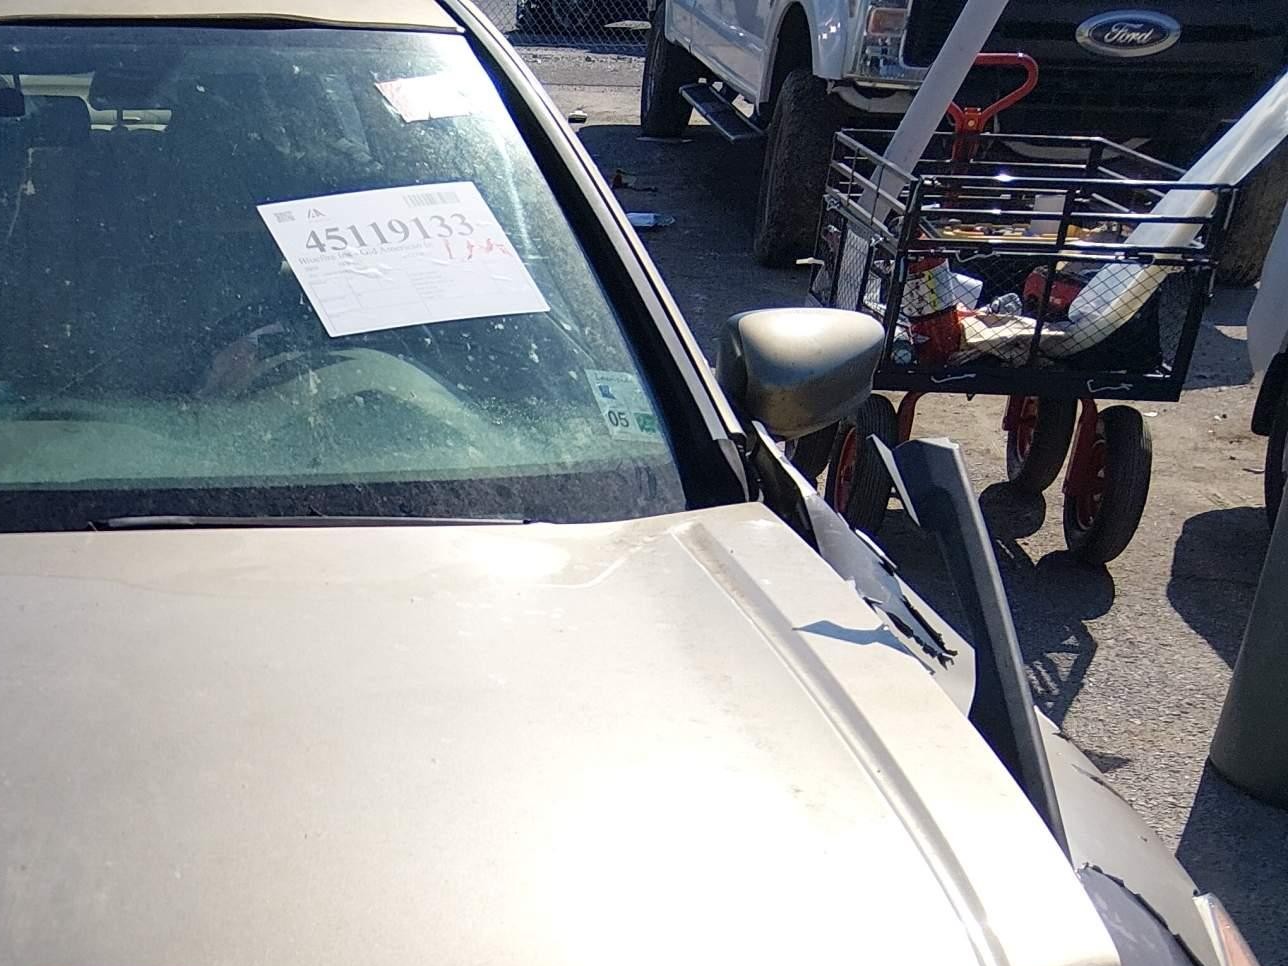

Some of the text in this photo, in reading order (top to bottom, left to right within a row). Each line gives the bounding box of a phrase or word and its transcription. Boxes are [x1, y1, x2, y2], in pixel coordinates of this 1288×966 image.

[1103, 22, 1154, 44] Ford
[305, 212, 475, 253] 45119133
[608, 411, 630, 428] 05
